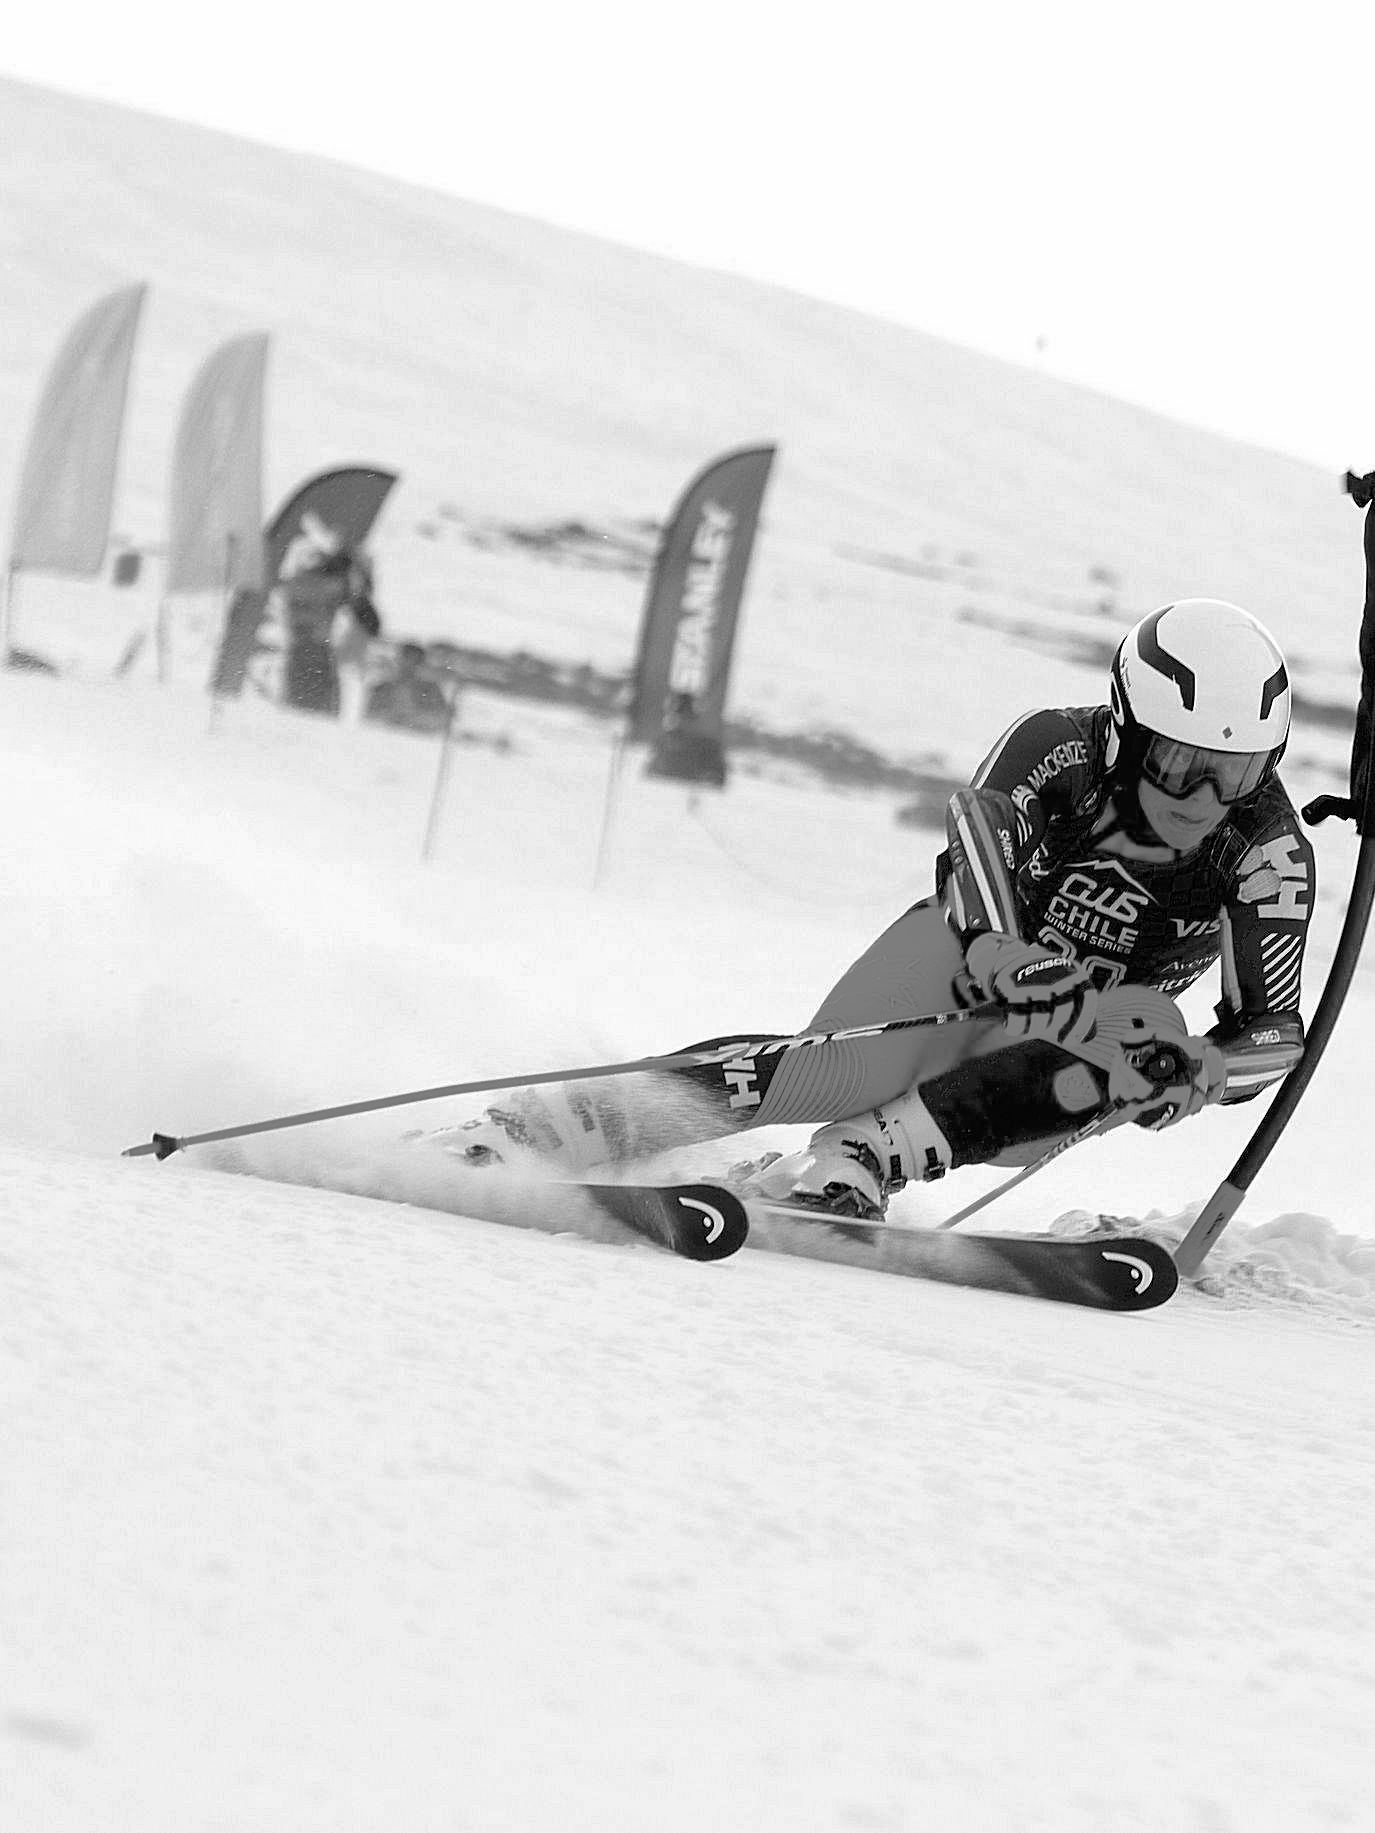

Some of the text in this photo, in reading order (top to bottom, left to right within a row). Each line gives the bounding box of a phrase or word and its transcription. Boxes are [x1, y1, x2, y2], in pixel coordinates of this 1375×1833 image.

[669, 501, 735, 692] STANLEY
[1044, 911, 1088, 942] WINTER
[1089, 935, 1131, 954] SERIES
[1048, 895, 1140, 949] CHILE
[1169, 918, 1221, 938] VIS
[1017, 957, 1071, 982] reusch
